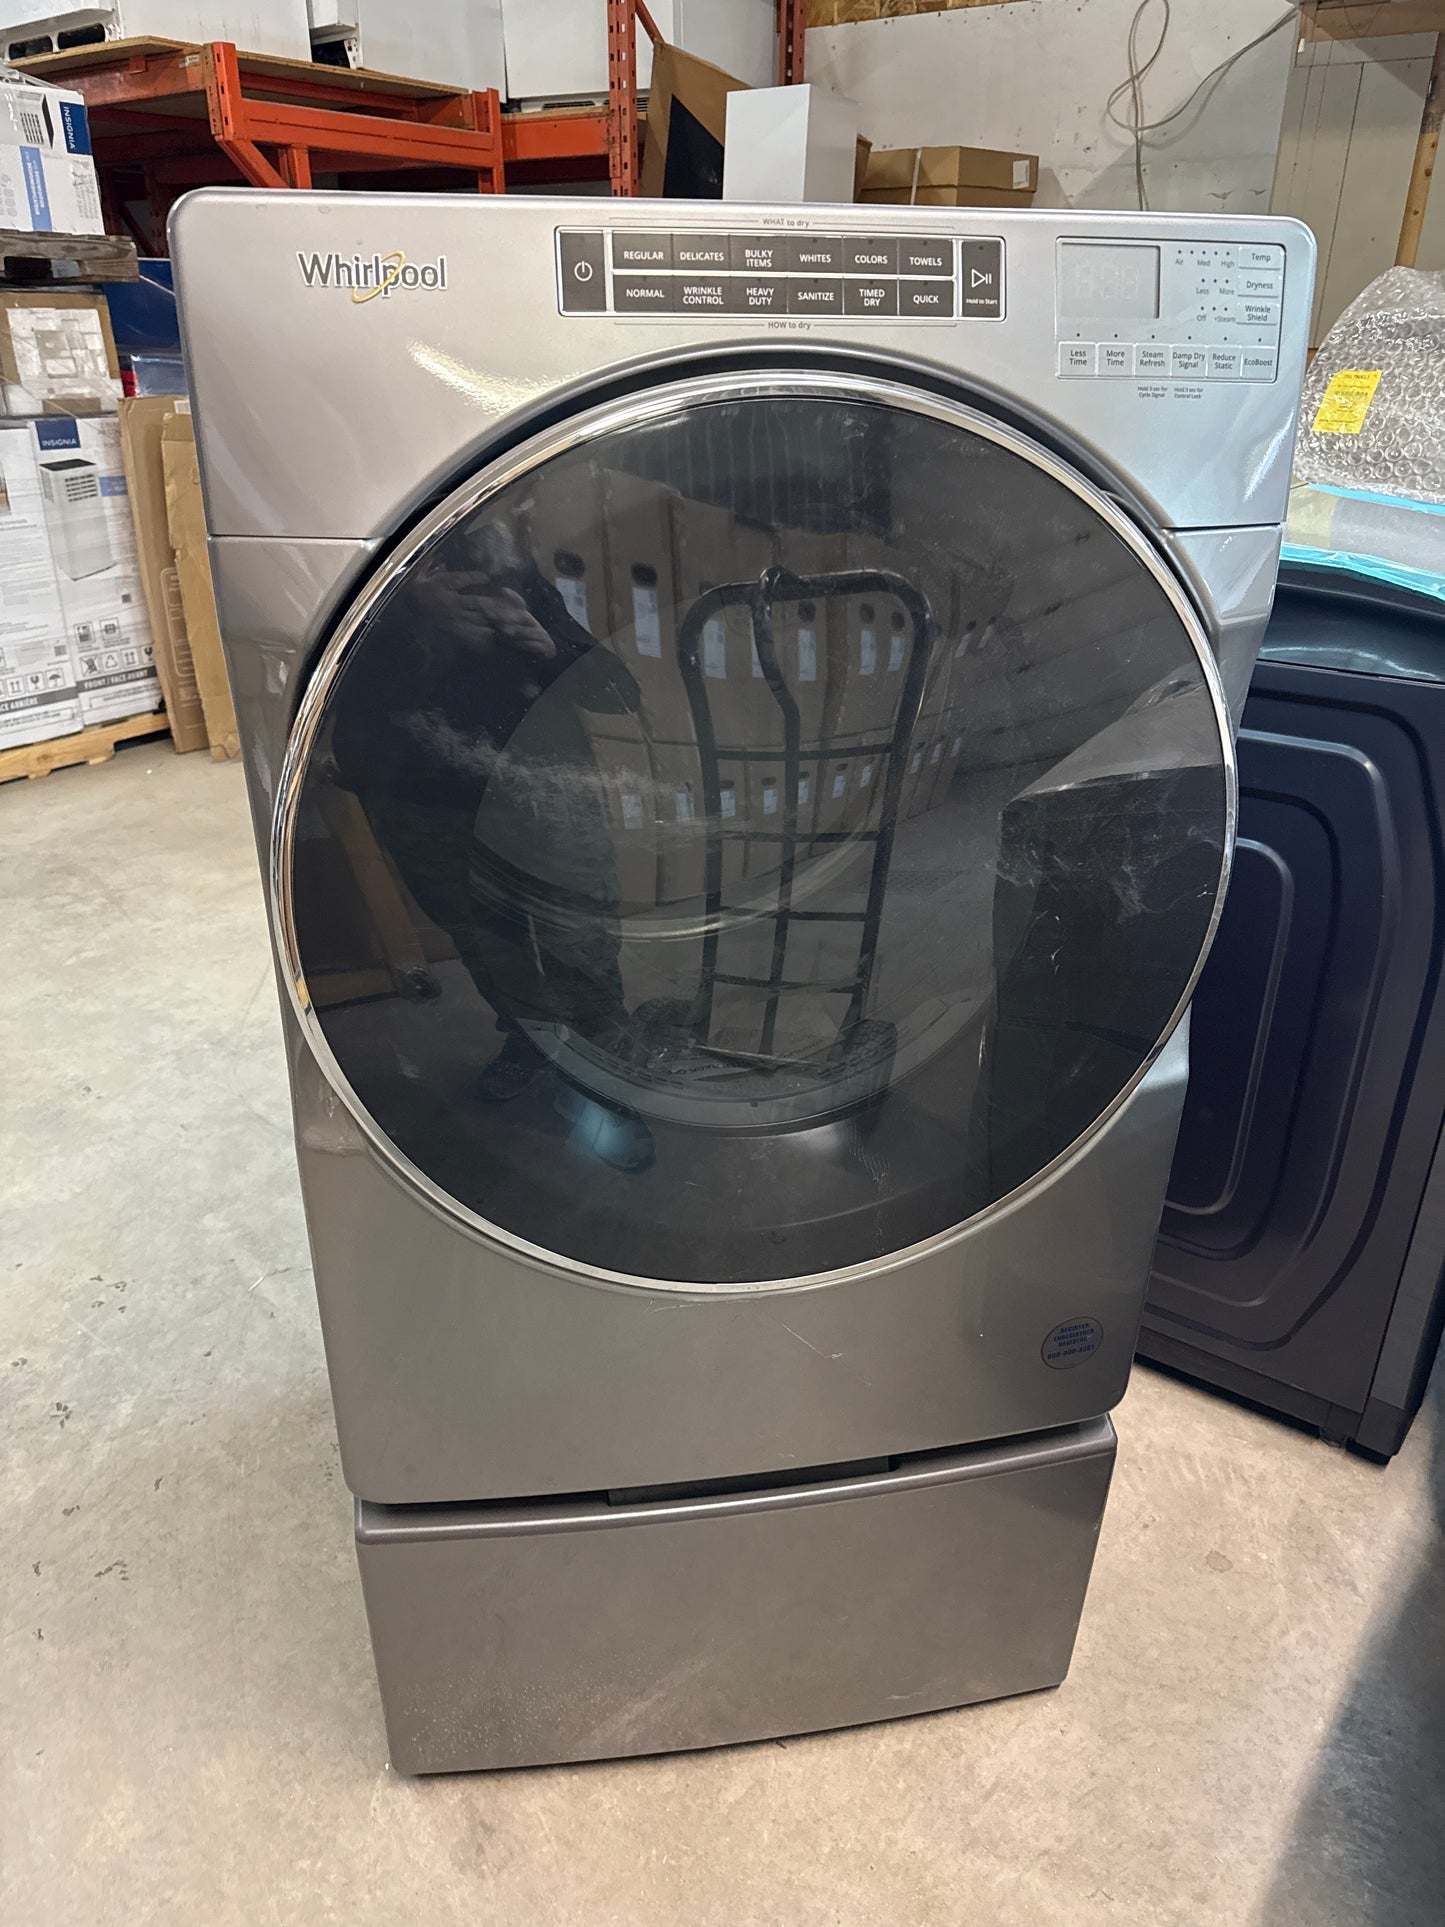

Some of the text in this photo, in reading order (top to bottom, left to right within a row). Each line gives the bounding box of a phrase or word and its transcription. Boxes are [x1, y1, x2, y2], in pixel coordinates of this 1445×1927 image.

[63, 106, 76, 149] INSIGNIA
[797, 219, 810, 228] dry
[623, 251, 664, 260] REGULAR
[680, 252, 725, 261] DELICATES
[745, 249, 773, 258] BULKY
[1251, 253, 1271, 263] Temp
[746, 258, 773, 268] ITEMS
[799, 254, 832, 263] WHITES
[855, 254, 888, 264] COLORS
[909, 257, 942, 266] TOWELS
[296, 252, 448, 298] Whirlpool
[1246, 281, 1273, 290] Dryness
[626, 288, 665, 298] NORMAL
[683, 286, 723, 295] WRINKLE
[746, 287, 775, 296] HEAVY
[859, 288, 885, 297] TIMED
[682, 296, 724, 305] CONTROL
[748, 296, 773, 306] DUTY
[797, 292, 835, 301] SANITIZE
[913, 294, 939, 304] QUICK
[864, 298, 881, 307] DRY
[1245, 305, 1271, 314] Wrinkle
[798, 321, 811, 331] dry
[1106, 350, 1125, 358] More
[1172, 352, 1206, 362] Damp Dry
[1212, 354, 1236, 362] Reduce
[1139, 359, 1166, 367] Refresh
[1178, 360, 1199, 369] Signal
[1244, 358, 1273, 366] EcoBoost
[42, 437, 77, 447] INSIGNIA
